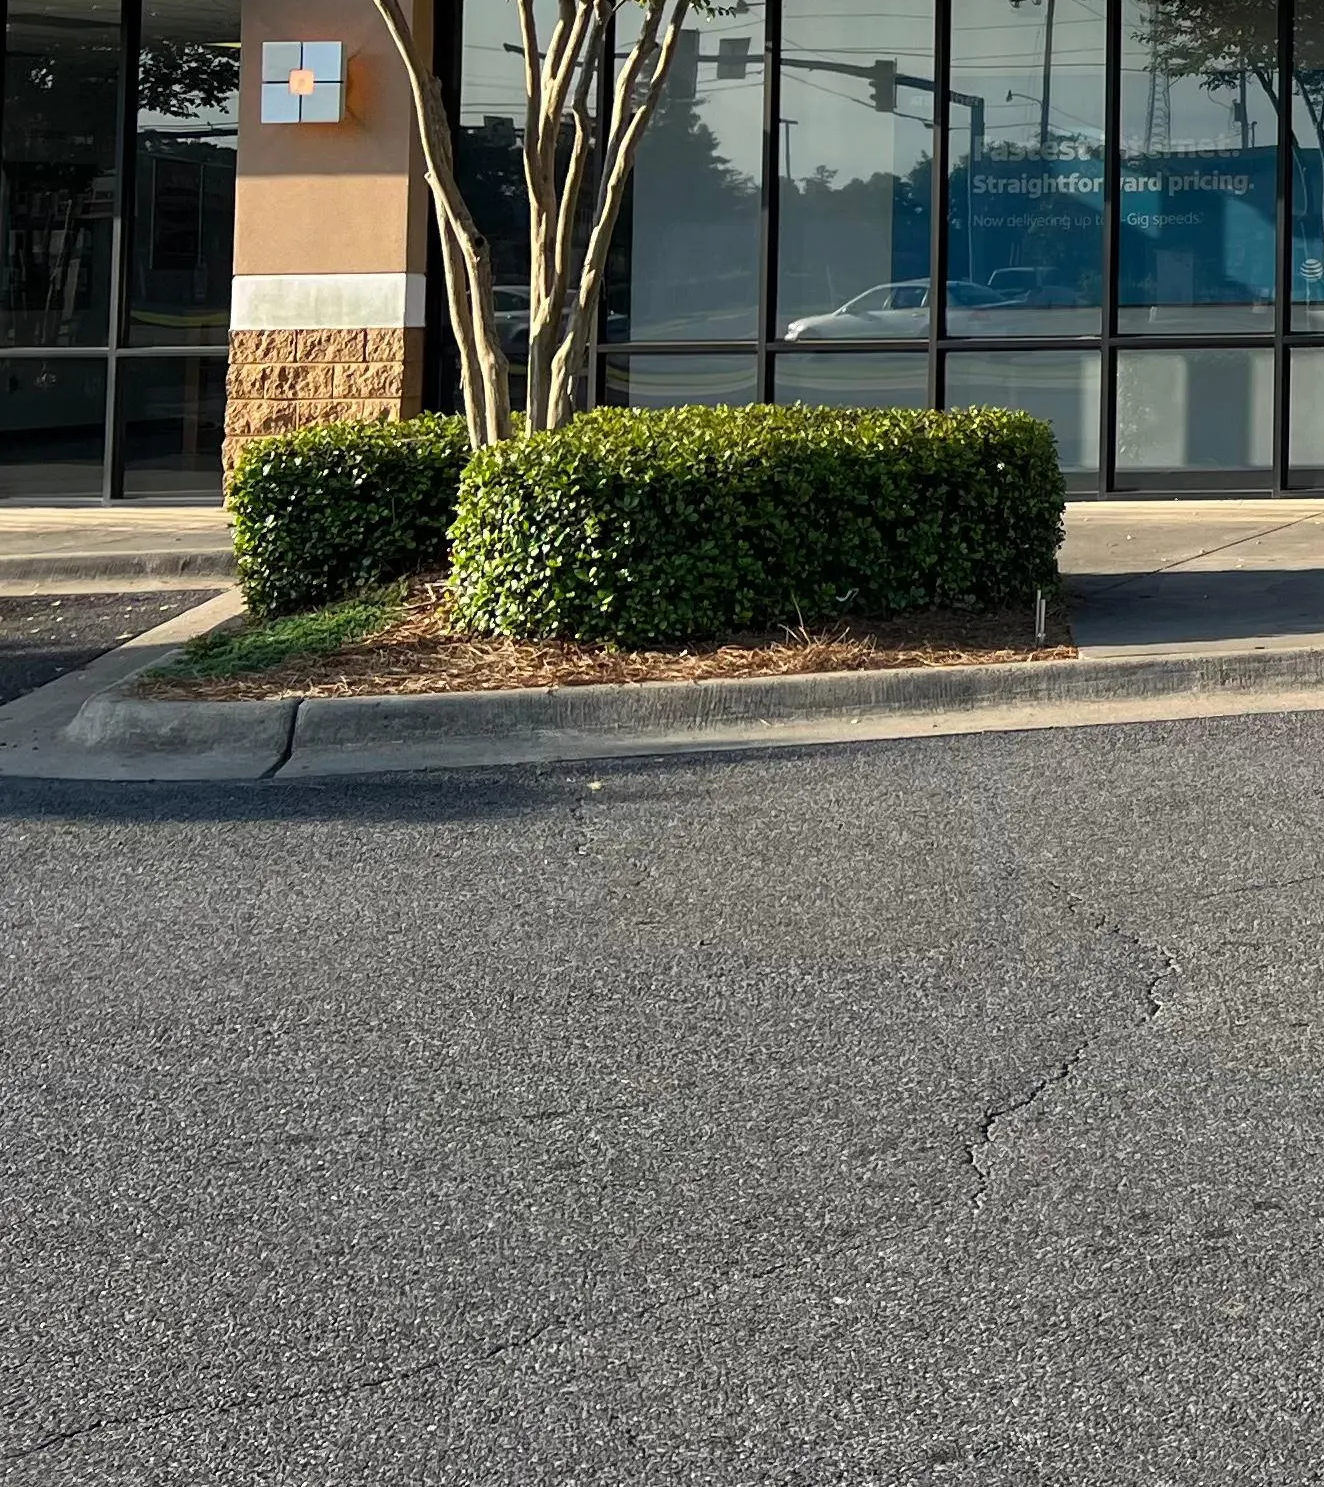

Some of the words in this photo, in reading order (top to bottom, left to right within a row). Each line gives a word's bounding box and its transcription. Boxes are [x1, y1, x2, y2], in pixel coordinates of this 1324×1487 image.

[972, 170, 1162, 198] Straightforard
[1169, 170, 1255, 197] pricing.
[974, 215, 1005, 226] Now
[1007, 213, 1071, 229] delivering
[1075, 216, 1090, 228] up
